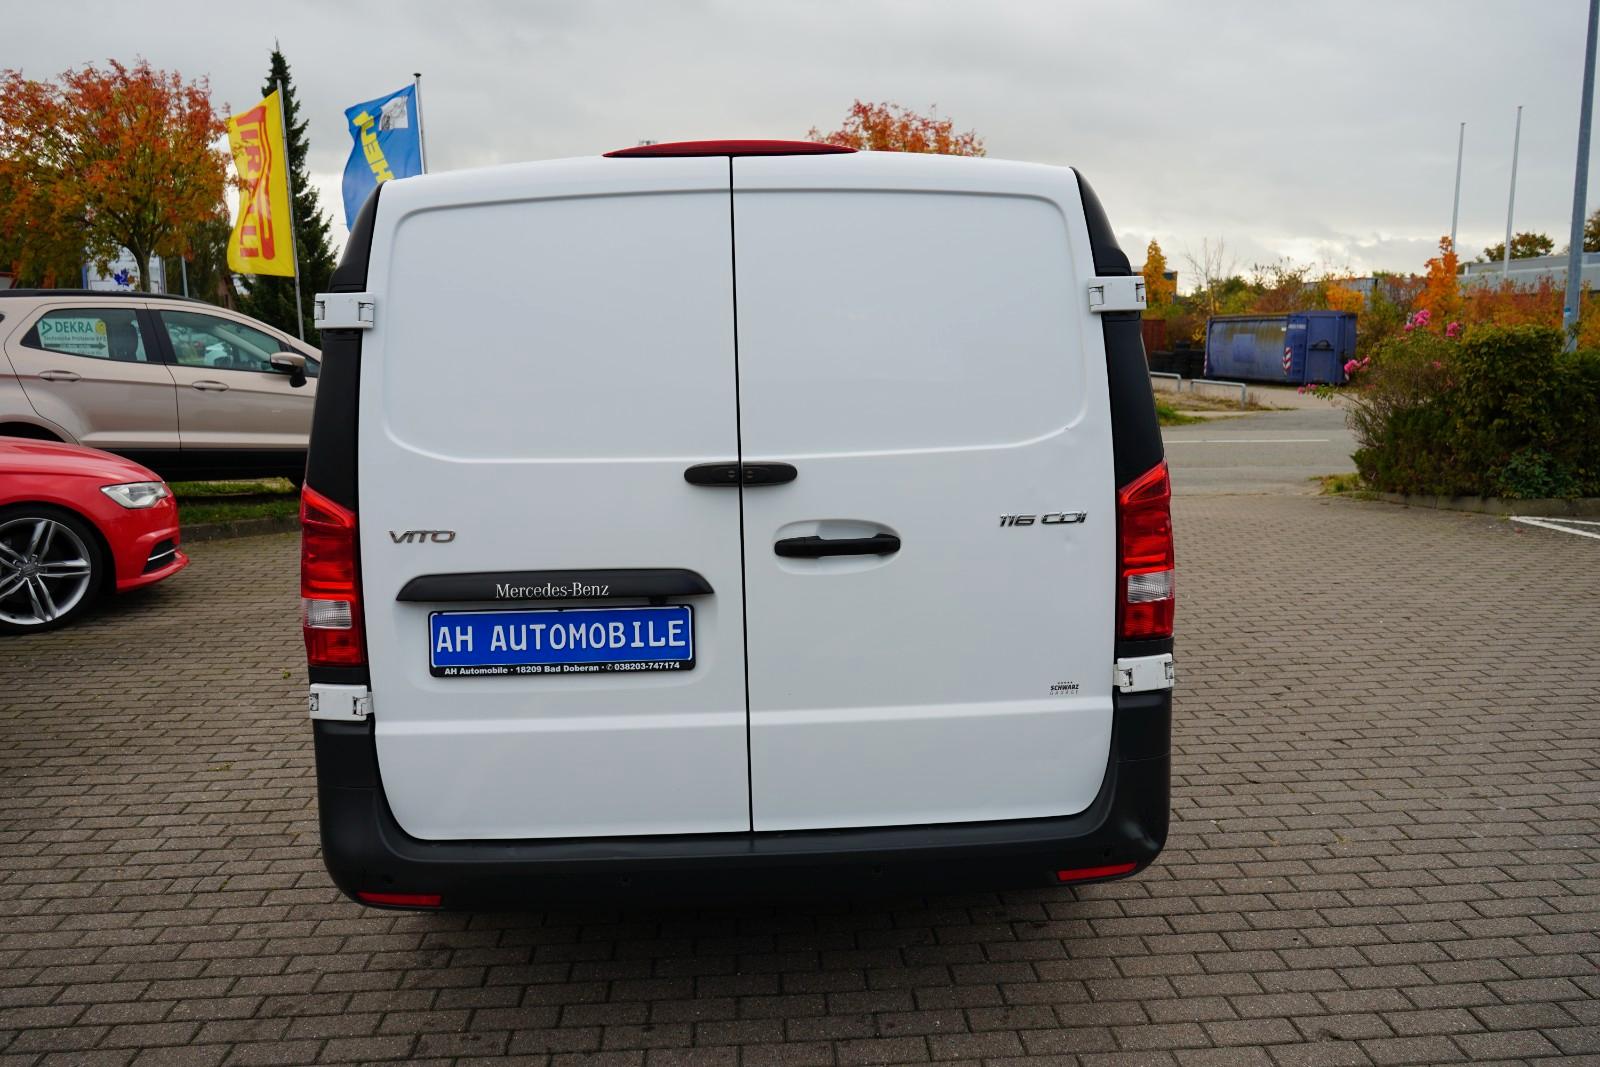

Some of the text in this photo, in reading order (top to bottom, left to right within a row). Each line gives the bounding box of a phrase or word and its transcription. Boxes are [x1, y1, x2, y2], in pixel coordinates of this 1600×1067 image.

[55, 321, 93, 333] DEKRA
[1000, 511, 1087, 527] 116 CDI
[388, 530, 456, 544] VITO
[495, 582, 609, 599] Mercedes-Benz
[436, 619, 687, 653] AH AUTOMOBILE
[459, 667, 508, 675] Automobile
[515, 665, 542, 673] 18209
[544, 665, 561, 673] Bad
[563, 664, 600, 672] Doberan
[614, 662, 680, 671] 038203-747174
